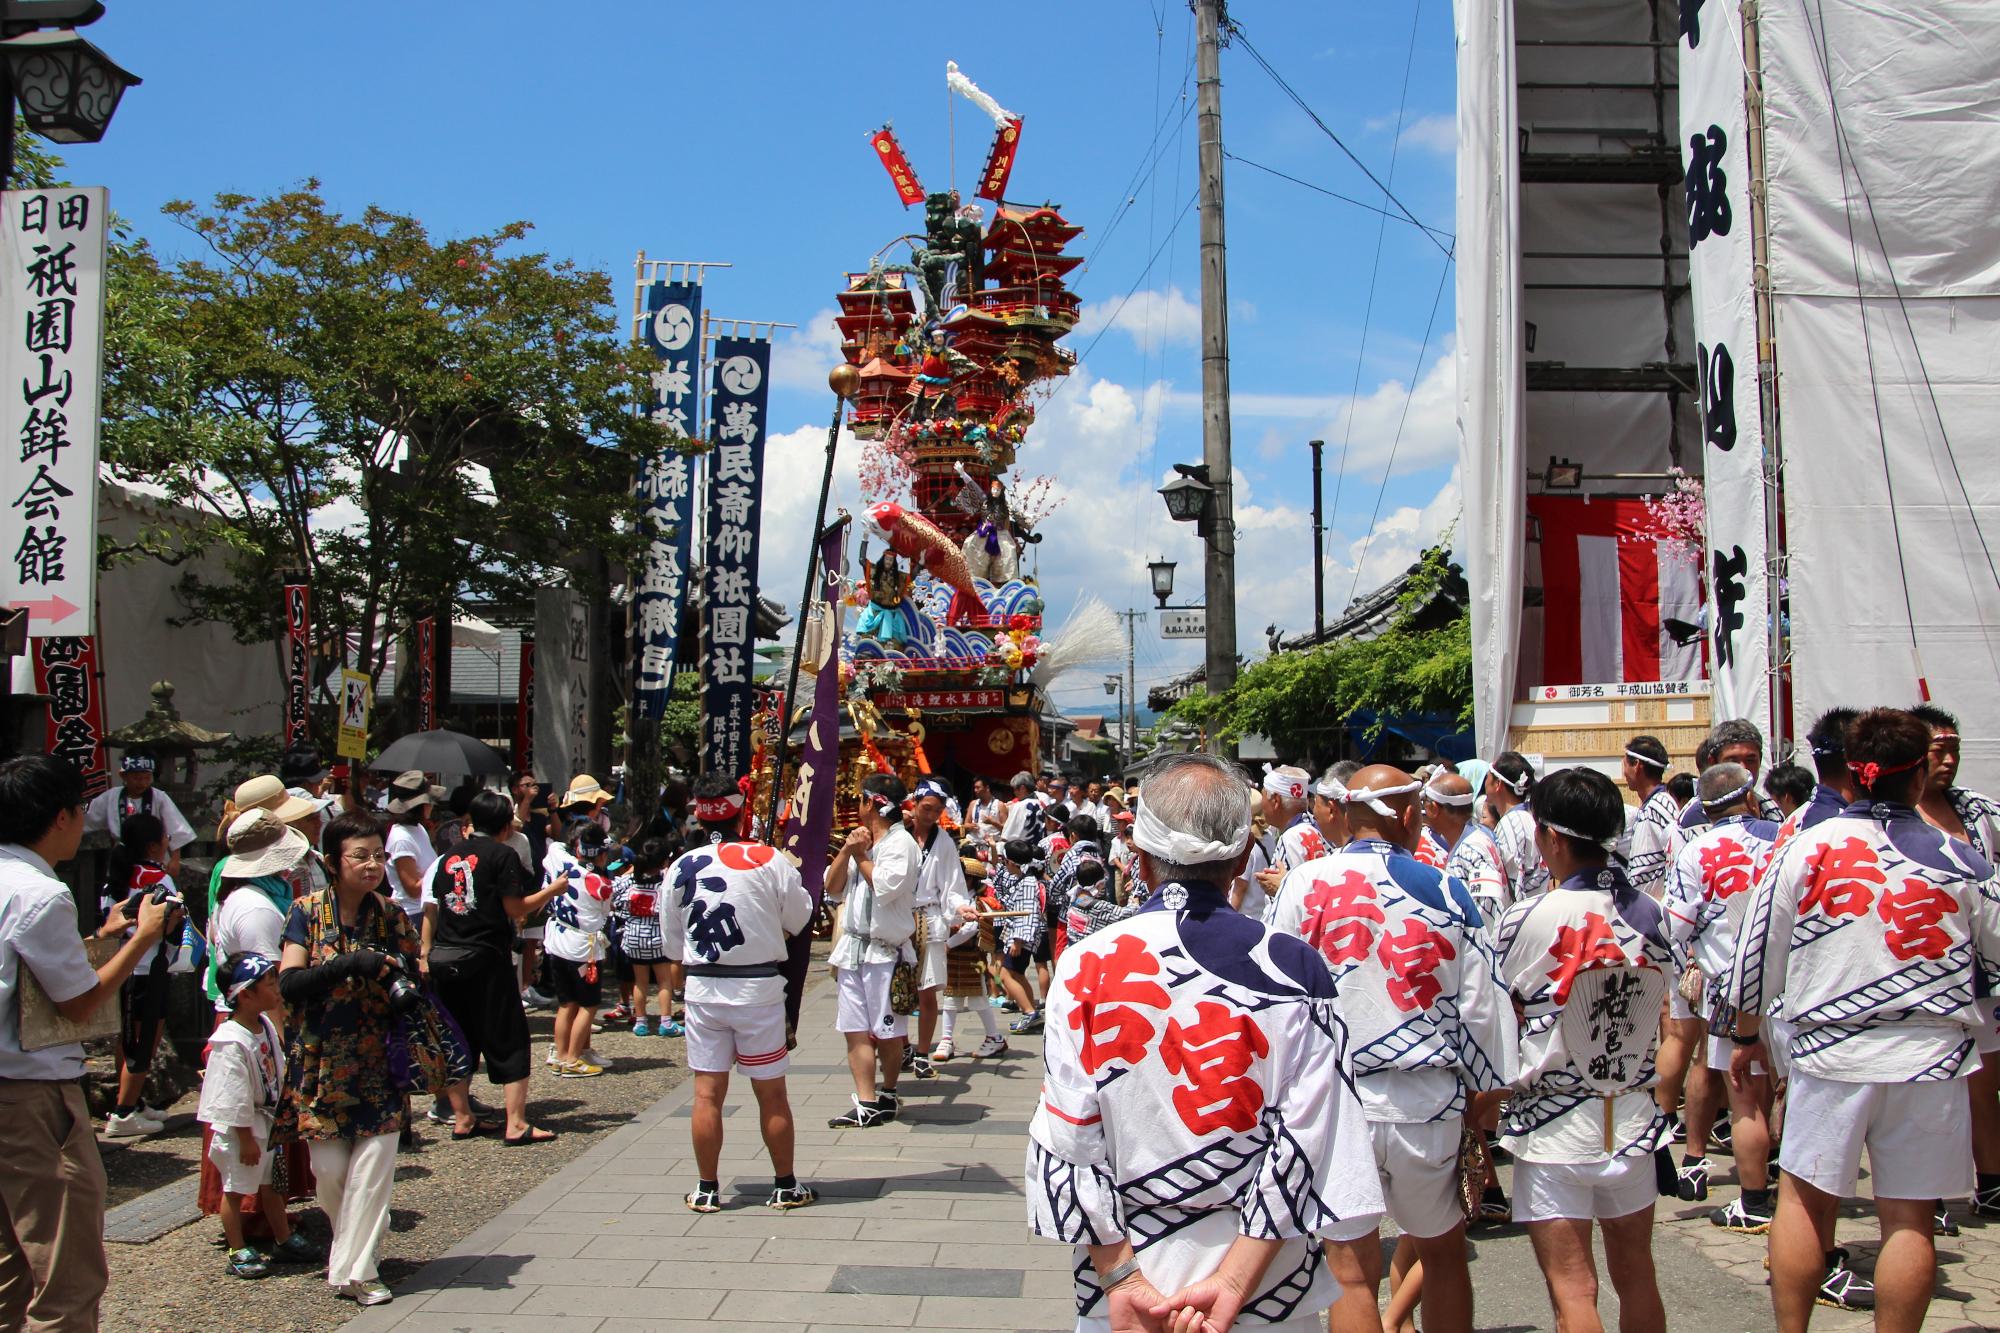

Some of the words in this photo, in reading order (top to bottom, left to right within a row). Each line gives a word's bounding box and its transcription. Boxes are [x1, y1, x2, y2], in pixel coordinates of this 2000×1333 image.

[20, 194, 89, 233] 日田
[988, 156, 1008, 191] 川原町
[12, 242, 76, 585] 祇園山鉾会館
[1568, 686, 1605, 698] 御芳名
[324, 903, 333, 925] Nikon
[674, 855, 746, 962] 大和
[1300, 869, 1456, 1013] 若宮
[1799, 836, 1959, 961] 若宮
[1065, 934, 1269, 1136] 若宮
